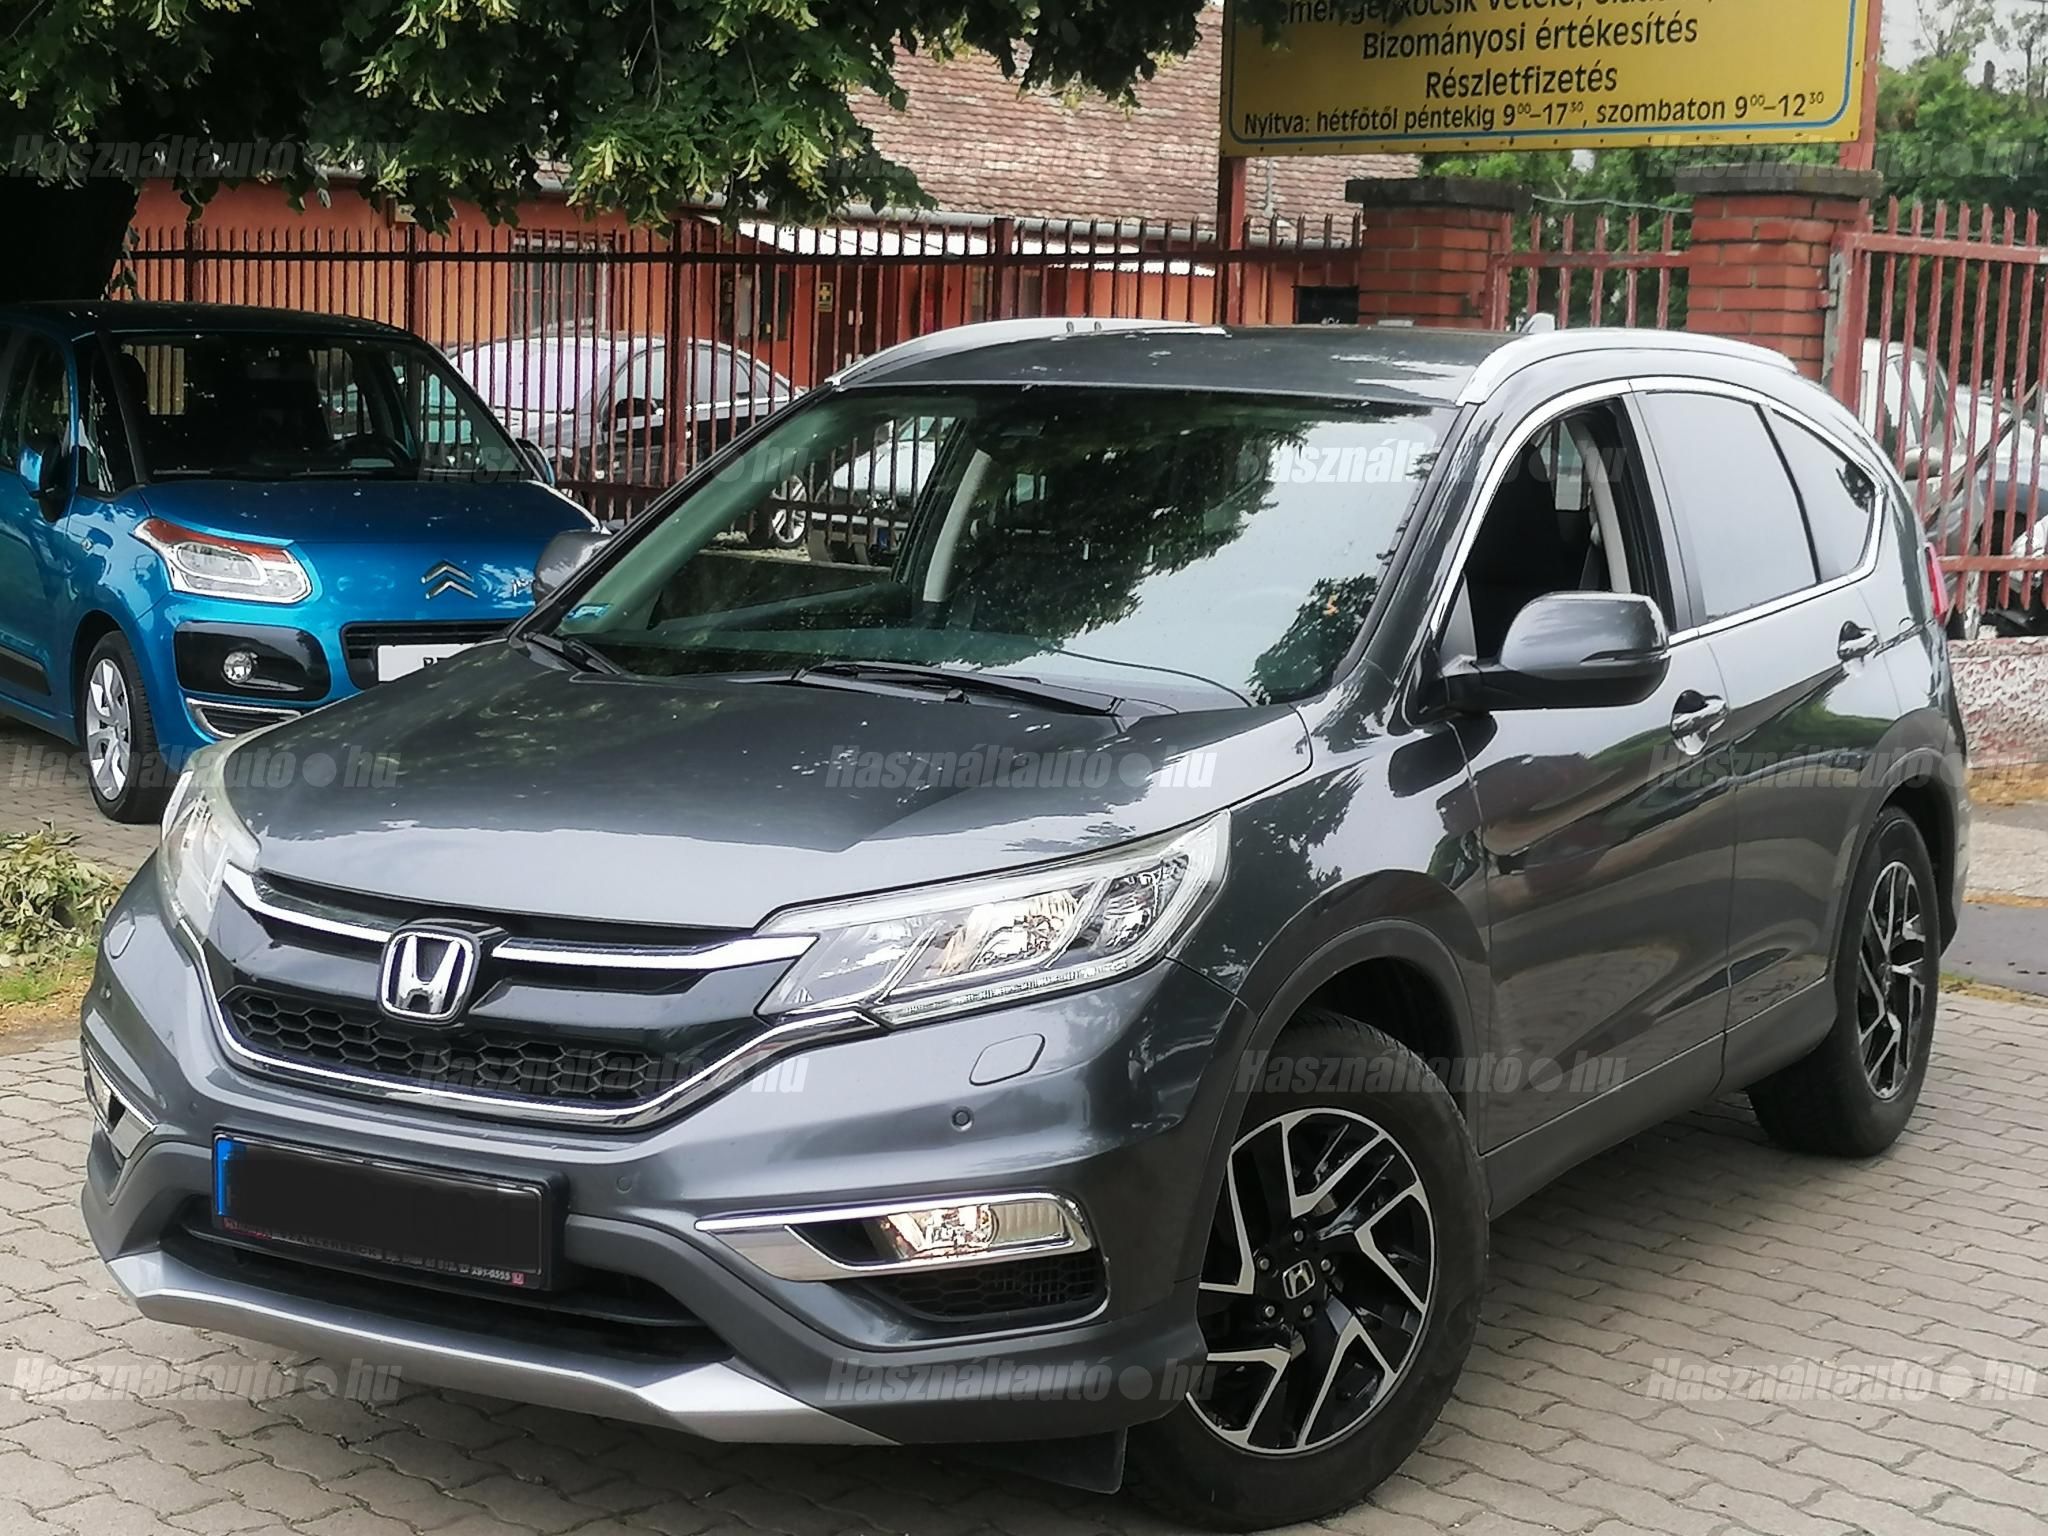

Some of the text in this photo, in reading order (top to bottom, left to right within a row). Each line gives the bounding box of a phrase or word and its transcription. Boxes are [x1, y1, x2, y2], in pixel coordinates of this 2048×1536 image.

[1363, 10, 1698, 59] Bizományosi értékesítés
[1426, 60, 1618, 99] Részletfizetés
[1244, 113, 1310, 138] Nyitva:
[1316, 105, 1398, 131] hétfőtől
[1404, 104, 1495, 133] péntekig
[1596, 97, 1726, 123] szombaton
